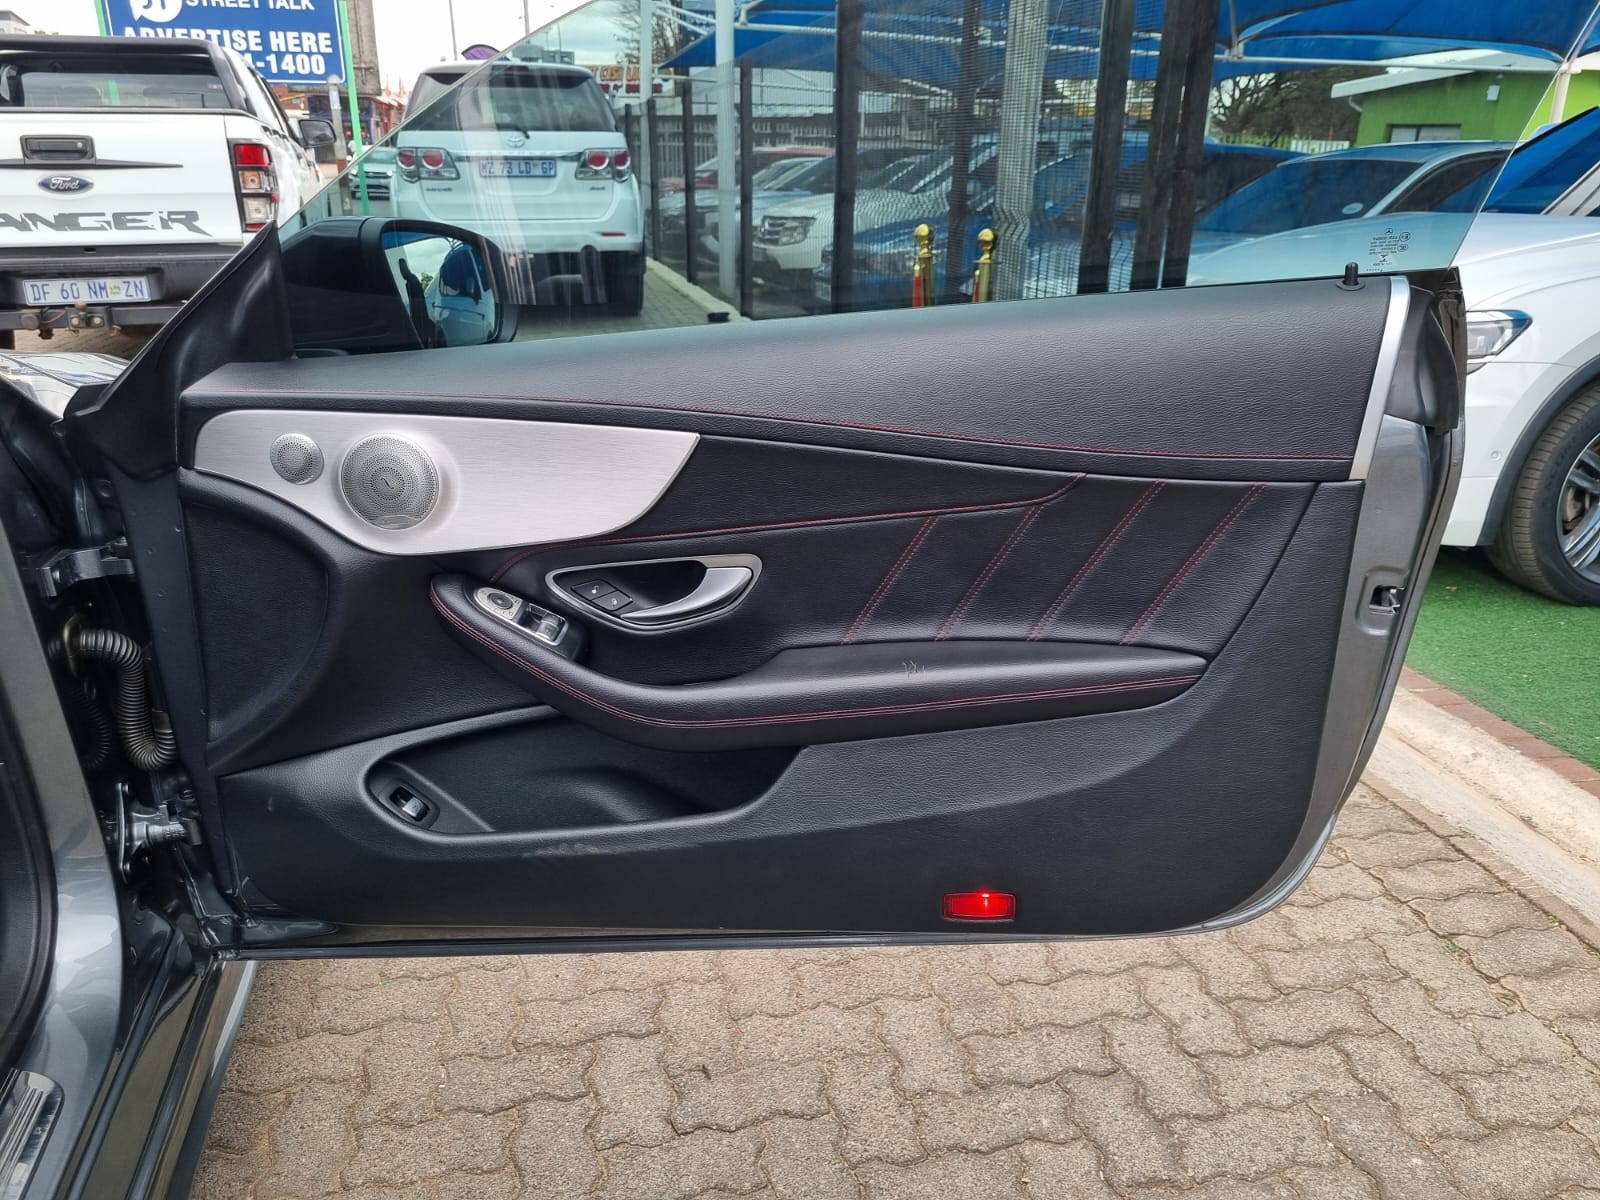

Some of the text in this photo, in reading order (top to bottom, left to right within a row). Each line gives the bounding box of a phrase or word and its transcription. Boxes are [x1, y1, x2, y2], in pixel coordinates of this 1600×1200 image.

[269, 31, 333, 54] HERE
[541, 161, 554, 175] GP
[50, 176, 81, 191] Ford
[88, 281, 109, 300] NM
[122, 280, 145, 299] ZN
